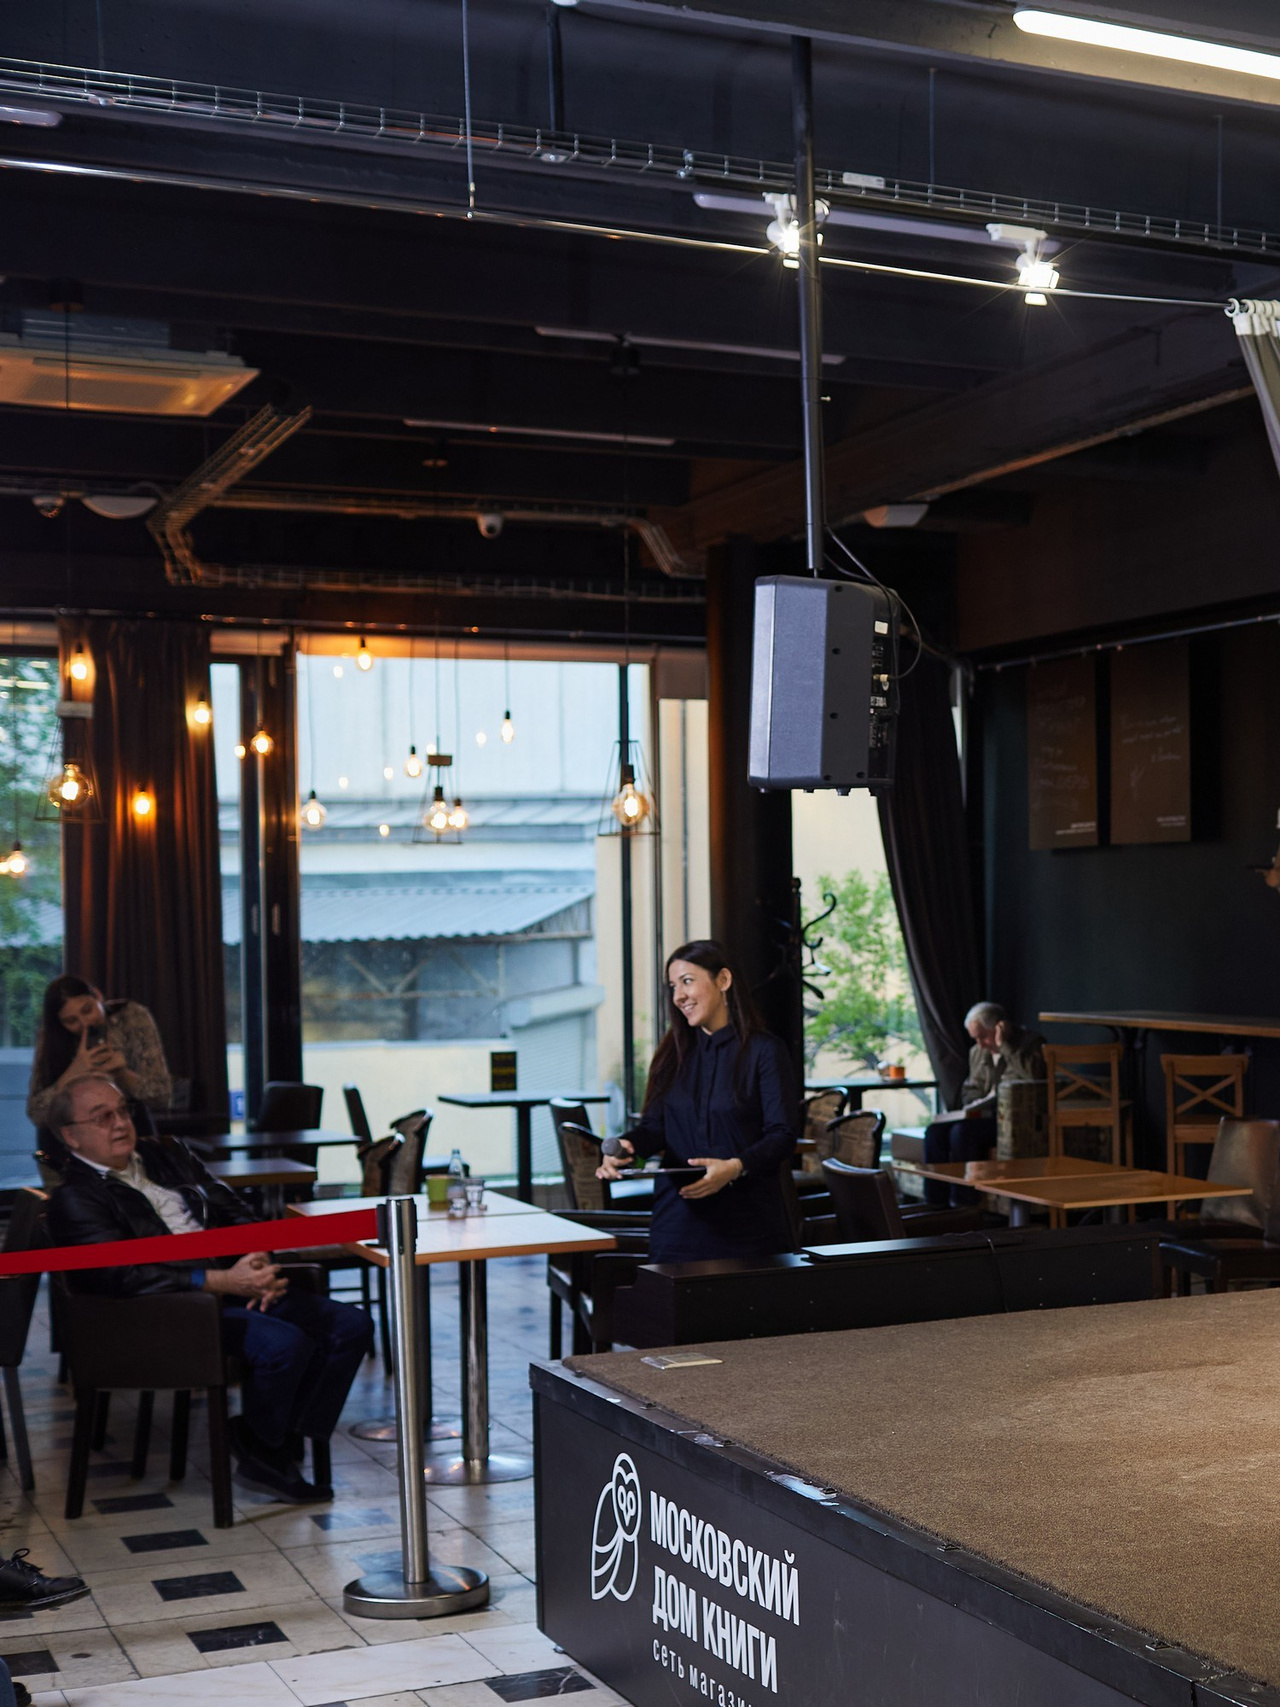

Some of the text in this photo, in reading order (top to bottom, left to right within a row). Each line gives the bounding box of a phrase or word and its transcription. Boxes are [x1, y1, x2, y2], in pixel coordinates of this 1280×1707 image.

[650, 1490, 800, 1626] МОСКОВСКИЙ
[652, 1565, 778, 1694] ДОМ КНИГИ
[653, 1639, 685, 1679] сеть
